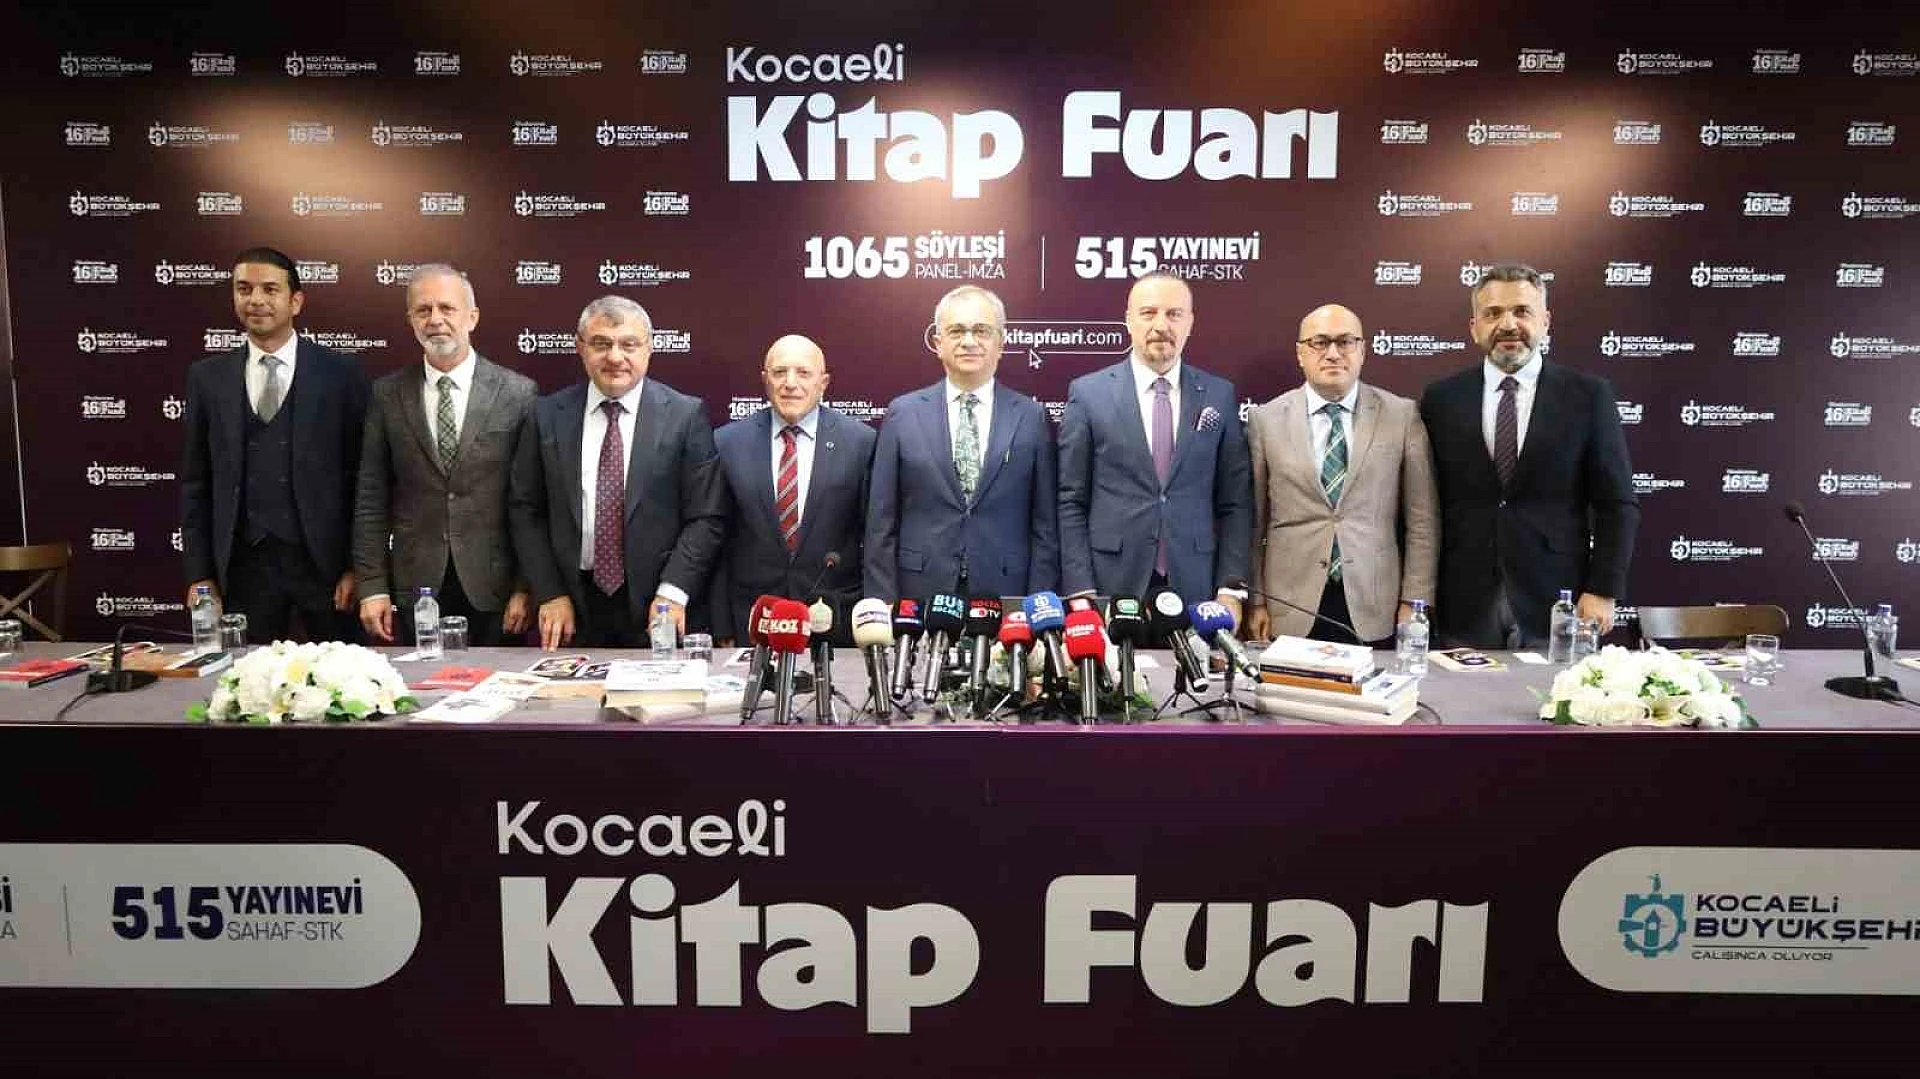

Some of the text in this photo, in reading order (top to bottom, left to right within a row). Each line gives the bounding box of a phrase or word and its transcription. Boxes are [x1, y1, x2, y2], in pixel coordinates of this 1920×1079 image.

[189, 57, 207, 72] 16
[414, 56, 432, 71] 16
[640, 55, 658, 70] 16
[728, 44, 904, 83] Kocaeli
[1517, 54, 1535, 68] 16
[1752, 55, 1770, 69] 16
[64, 127, 82, 142] 16
[511, 126, 529, 141] 16
[1380, 125, 1399, 140] 16
[1613, 126, 1631, 140] 16
[1847, 127, 1865, 141] 16
[729, 92, 1338, 197] Kitap Fuarı
[197, 197, 214, 211] 16
[420, 197, 437, 211] 16
[643, 196, 660, 211] 16
[1511, 196, 1529, 211] 16
[1743, 197, 1761, 212] 16
[804, 230, 1005, 279] 1065 SÖYLEŞİ
[1075, 231, 1260, 279] 515 YAYINEVİ
[73, 265, 90, 279] 16
[515, 266, 532, 280] 16
[1374, 266, 1392, 281] 16
[1604, 267, 1622, 282] 16
[1836, 268, 1854, 283] 16
[204, 334, 220, 347] 16
[654, 334, 662, 349] 6
[1003, 328, 1122, 348] kitapfuari.com
[1733, 337, 1751, 352] 16
[82, 401, 98, 414] 16
[729, 403, 744, 416] 16
[1824, 407, 1842, 422] 16
[1722, 474, 1740, 489] 16
[91, 533, 107, 546] 16
[497, 800, 786, 857] Kocaeli
[112, 878, 363, 940] 515 YAYINEVİ
[1697, 894, 1839, 913] KOCAELİ
[227, 921, 343, 942] SAHAF-STK
[1694, 917, 1920, 943] BÜYÜKŞEH
[501, 874, 1489, 1033] Kitap Fuarı
[1771, 952, 1834, 961] OLUYOR
